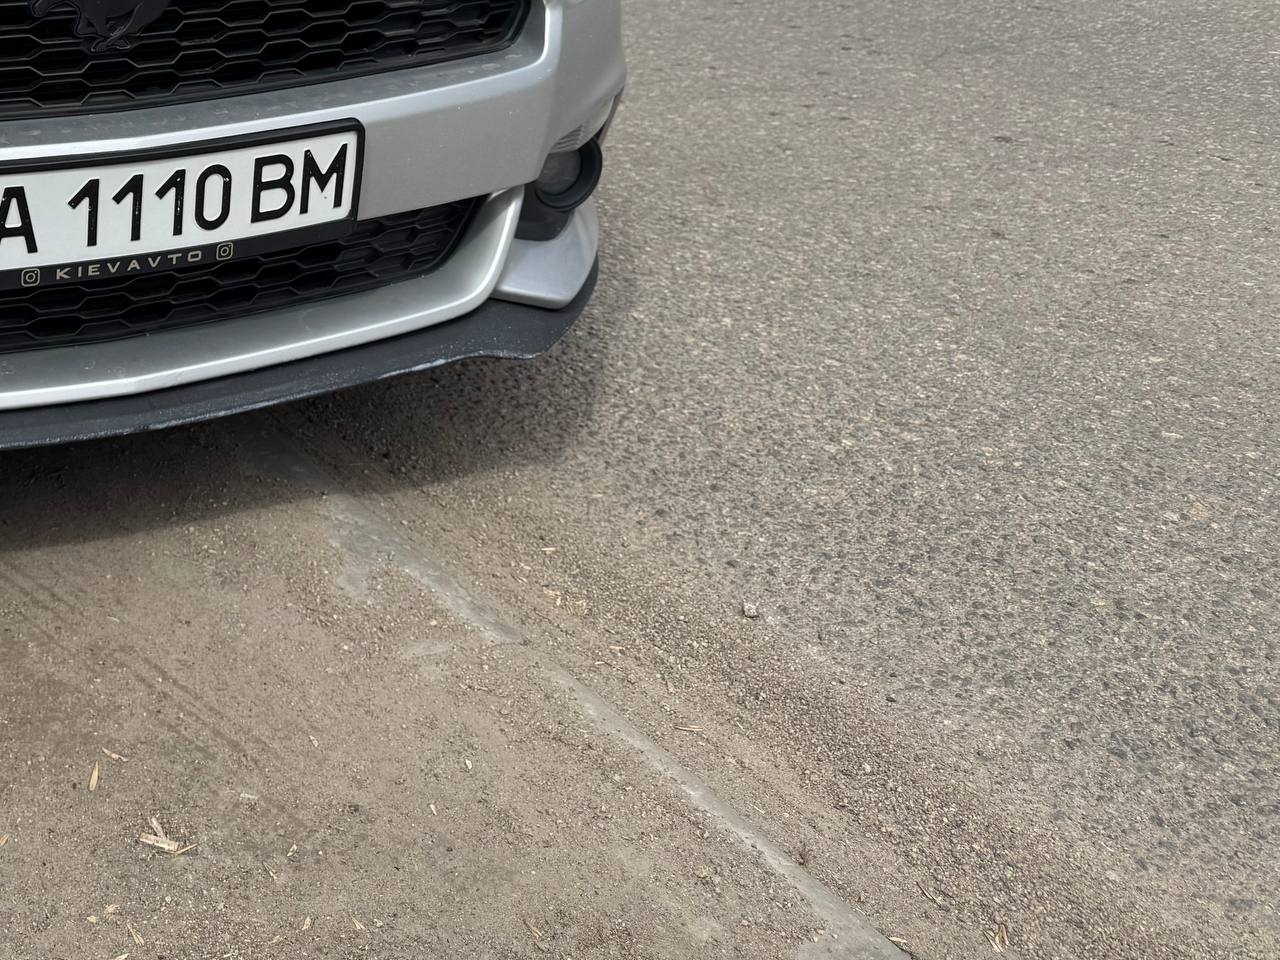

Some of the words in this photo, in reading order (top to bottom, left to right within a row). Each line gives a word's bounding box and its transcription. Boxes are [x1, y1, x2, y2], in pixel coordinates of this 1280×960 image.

[67, 164, 232, 246] 1110
[251, 143, 348, 223] BM
[56, 251, 202, 280] KIEVAVTO
